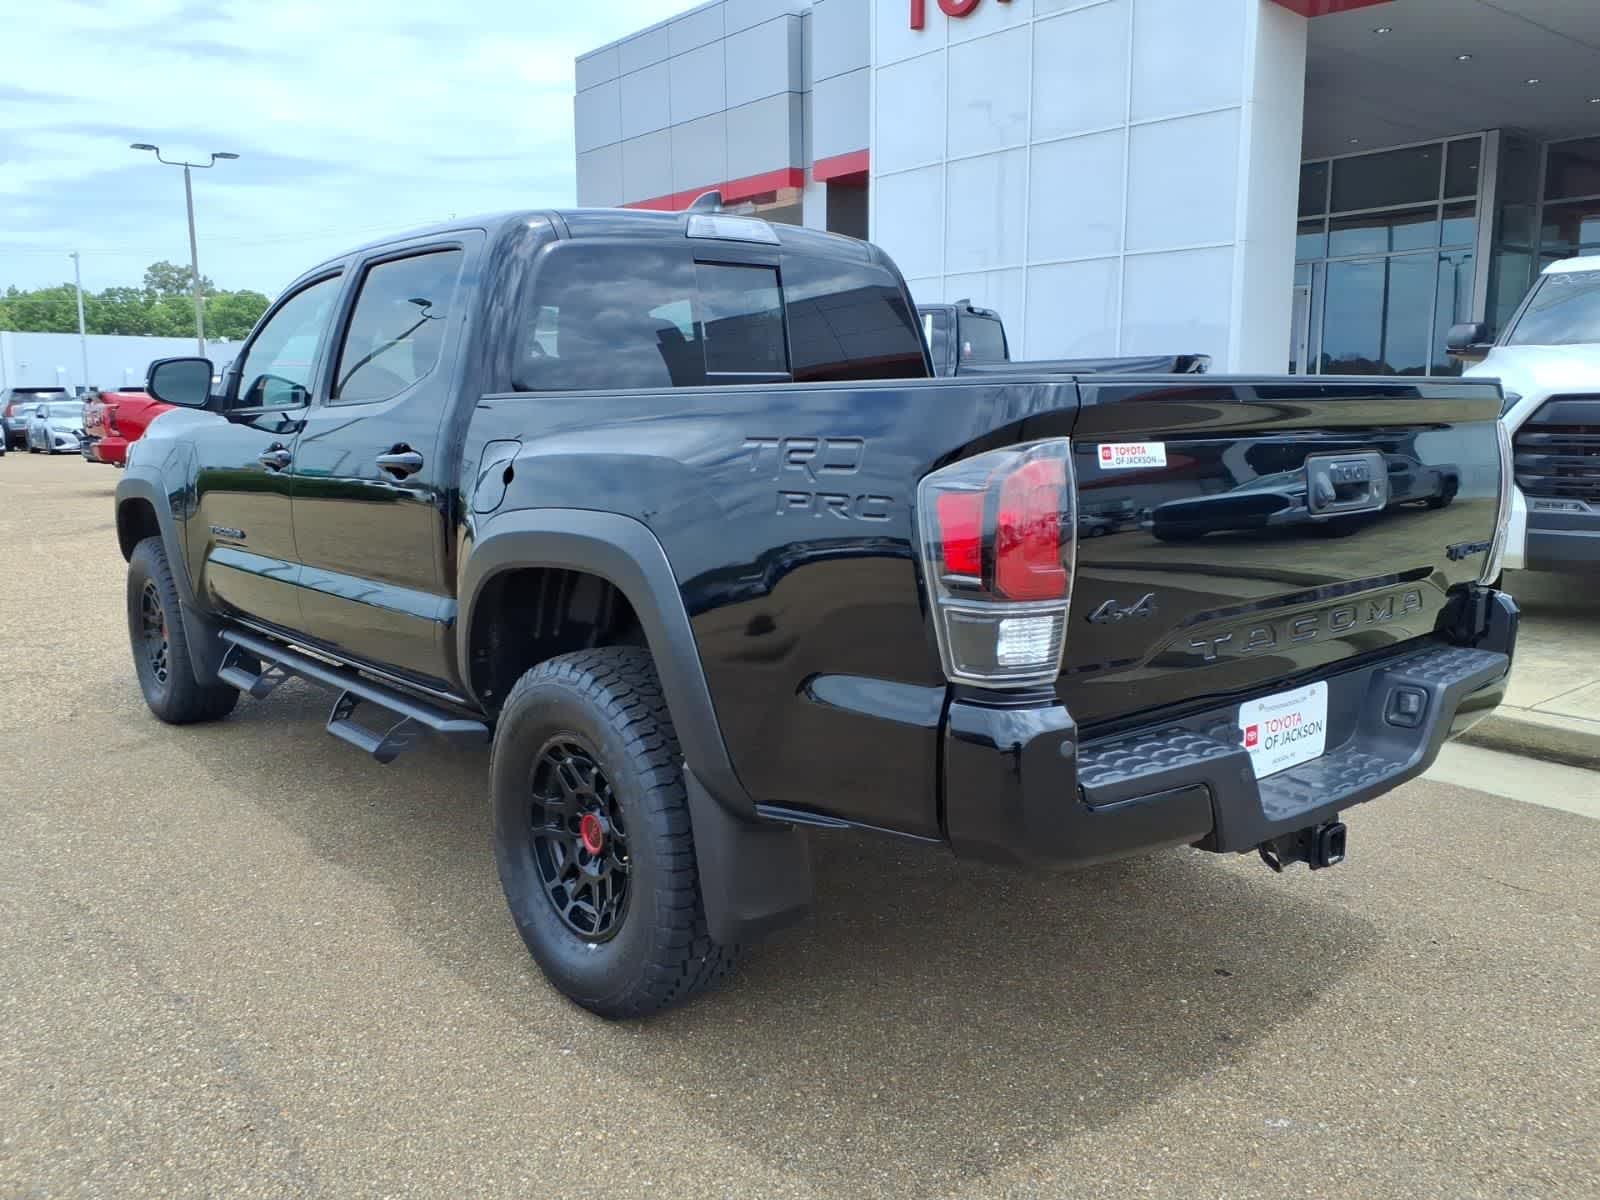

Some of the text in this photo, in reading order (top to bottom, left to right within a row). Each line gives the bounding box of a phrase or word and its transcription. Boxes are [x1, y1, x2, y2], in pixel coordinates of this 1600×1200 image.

[742, 436, 865, 484] TRD
[1115, 446, 1147, 456] TOYOTA
[1115, 456, 1125, 465] OF
[1126, 455, 1157, 465] JACKSON
[776, 490, 896, 522] PRO
[1188, 588, 1424, 661] TACOMA
[1264, 711, 1303, 734] TOYOTA
[1264, 719, 1323, 751] OF JACKSON
